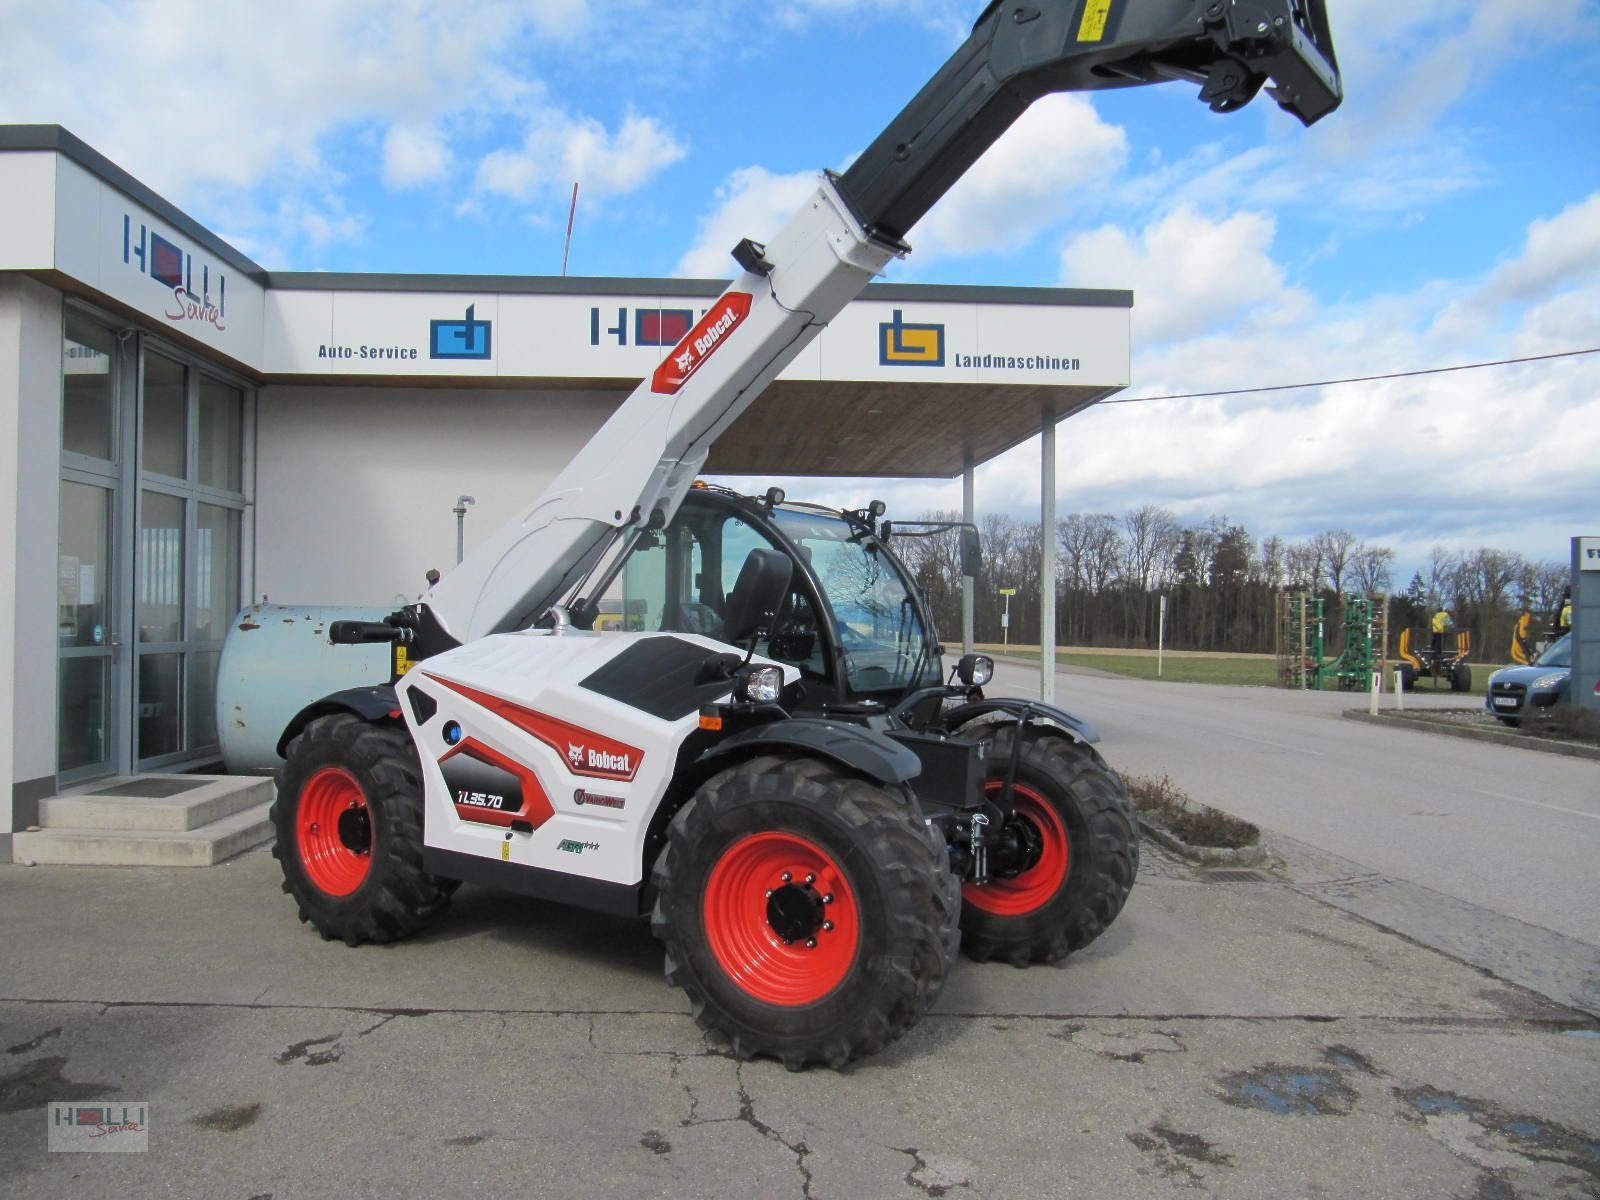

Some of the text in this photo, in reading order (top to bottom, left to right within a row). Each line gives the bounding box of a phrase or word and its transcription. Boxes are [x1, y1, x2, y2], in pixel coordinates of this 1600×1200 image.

[165, 287, 226, 331] Service
[694, 306, 737, 356] Bobcat
[318, 345, 418, 360] Auto-Service
[955, 353, 1081, 371] Landmaschinen
[588, 749, 631, 772] Bobcat
